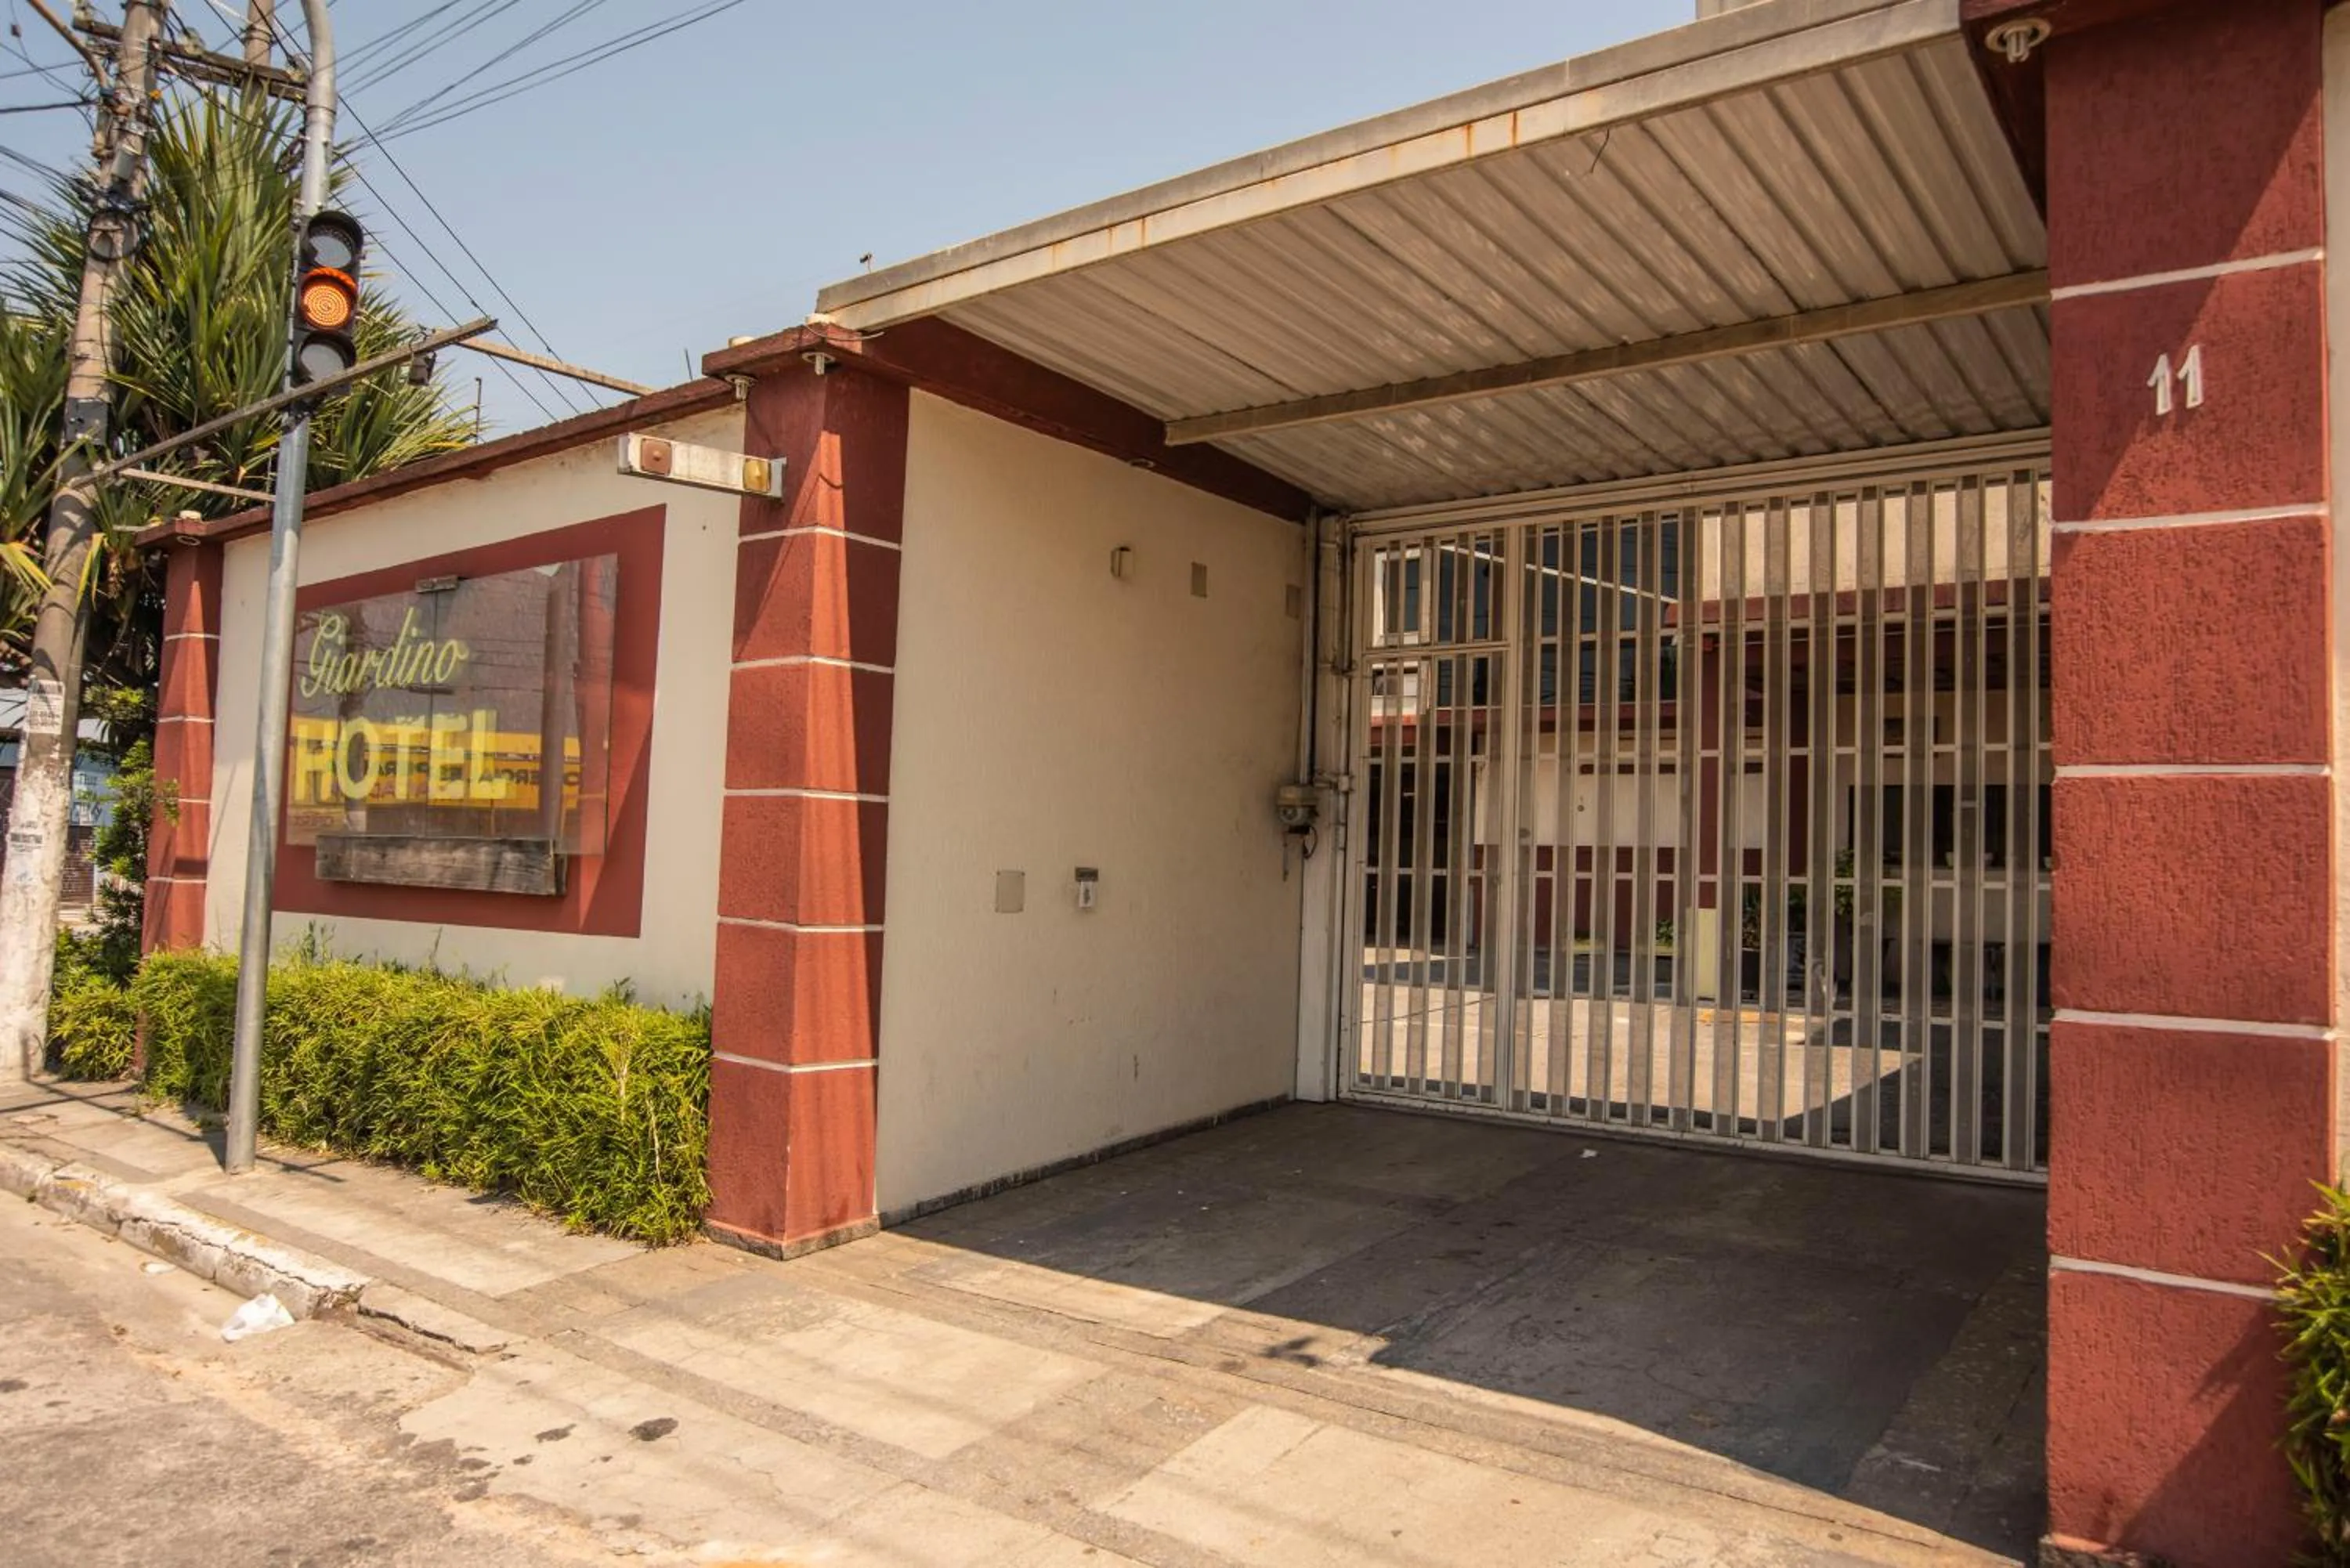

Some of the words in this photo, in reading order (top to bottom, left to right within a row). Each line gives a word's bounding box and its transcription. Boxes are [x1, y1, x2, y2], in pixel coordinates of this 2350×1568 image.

[2147, 344, 2204, 416] 11
[302, 606, 468, 698] Giardino
[295, 709, 508, 801] HOTEL
